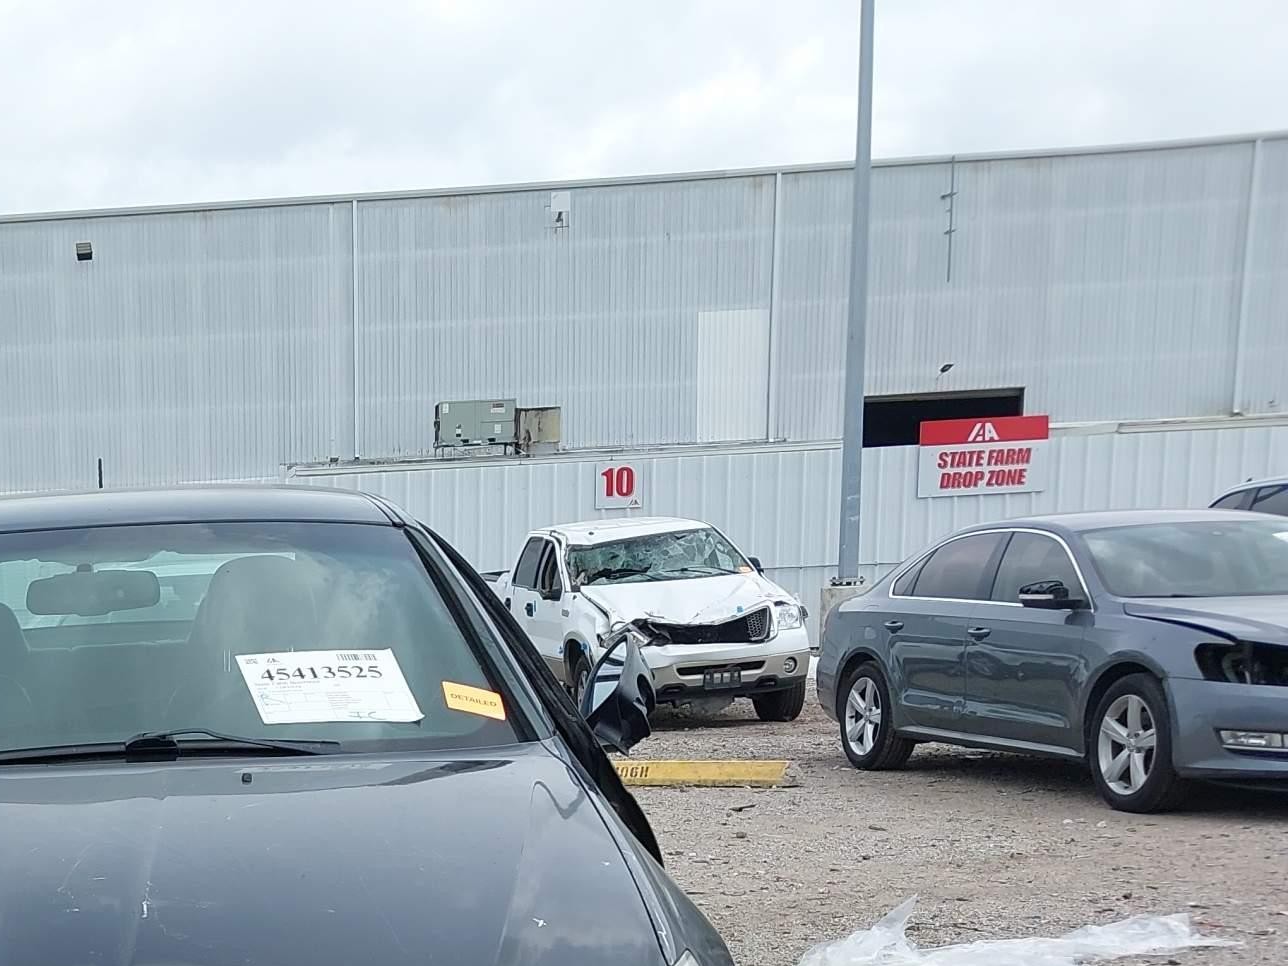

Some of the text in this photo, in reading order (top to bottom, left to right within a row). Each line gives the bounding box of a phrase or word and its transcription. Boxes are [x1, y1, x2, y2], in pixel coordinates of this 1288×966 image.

[937, 447, 1032, 469] STATE FARM
[601, 466, 634, 497] 10
[939, 468, 1027, 489] DROP ZONE
[261, 665, 383, 681] 45413525
[450, 693, 497, 707] DETAILED
